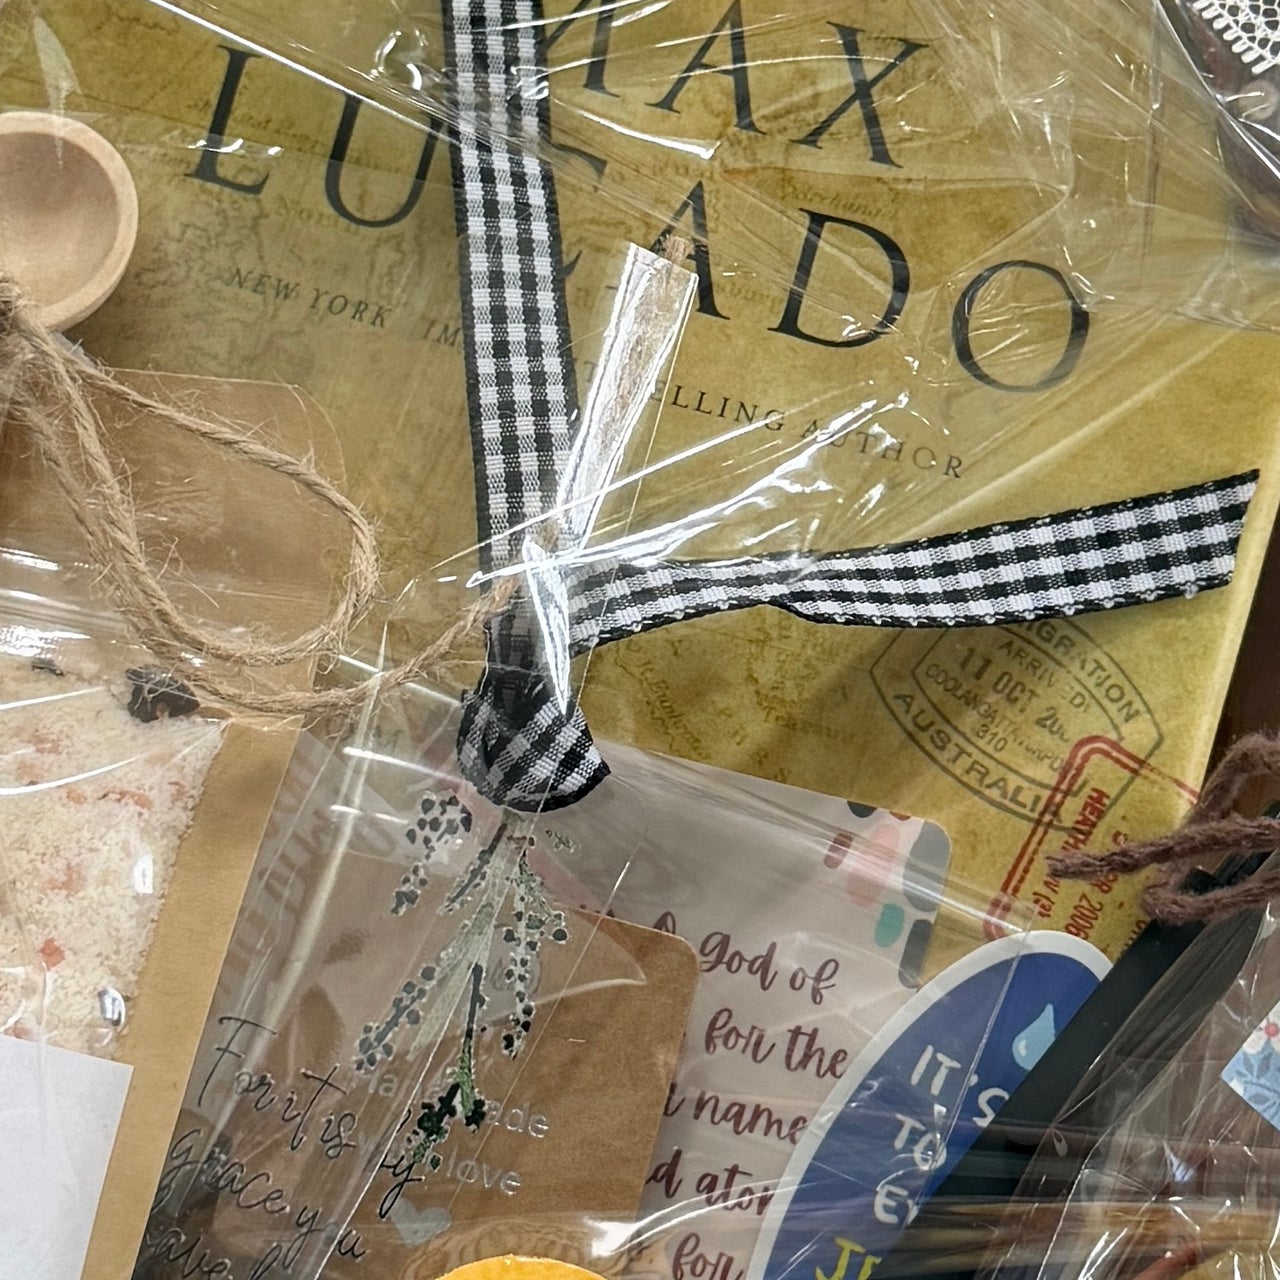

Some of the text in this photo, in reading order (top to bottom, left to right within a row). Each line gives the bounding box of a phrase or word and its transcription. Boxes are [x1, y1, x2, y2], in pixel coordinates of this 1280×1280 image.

[186, 45, 1090, 392] LUADO
[228, 266, 302, 301] NEW
[308, 286, 396, 328] YORK
[801, 416, 964, 479] AUTHOR
[976, 723, 1008, 753] 310
[698, 931, 841, 1005] god of
[198, 1016, 277, 1112] For
[704, 1007, 849, 1079] for the
[446, 1145, 522, 1196] love
